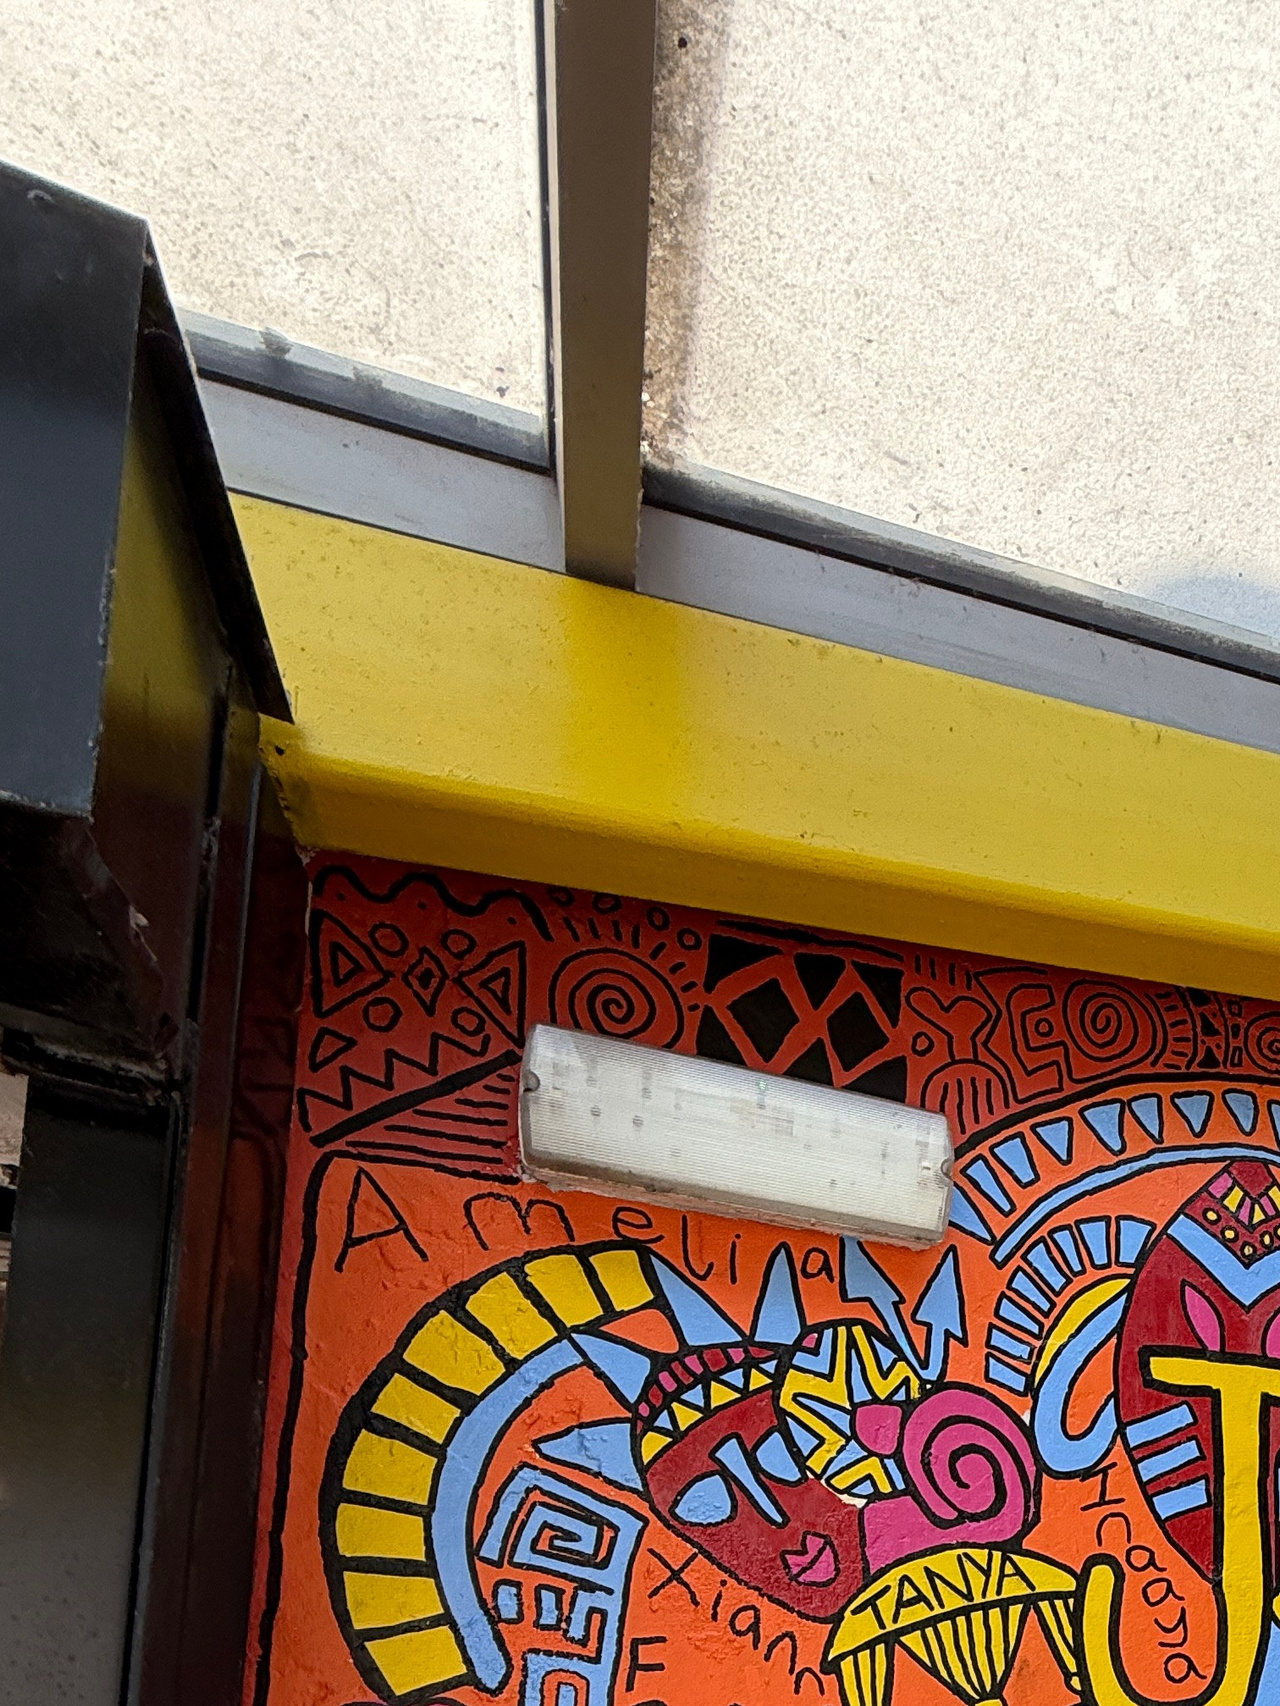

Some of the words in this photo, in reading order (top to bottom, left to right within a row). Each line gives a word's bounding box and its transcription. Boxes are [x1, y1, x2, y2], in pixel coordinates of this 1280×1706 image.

[334, 1166, 834, 1283] Amelia
[851, 1549, 1036, 1630] TANYA
[1079, 1461, 1207, 1683] Inaaya
